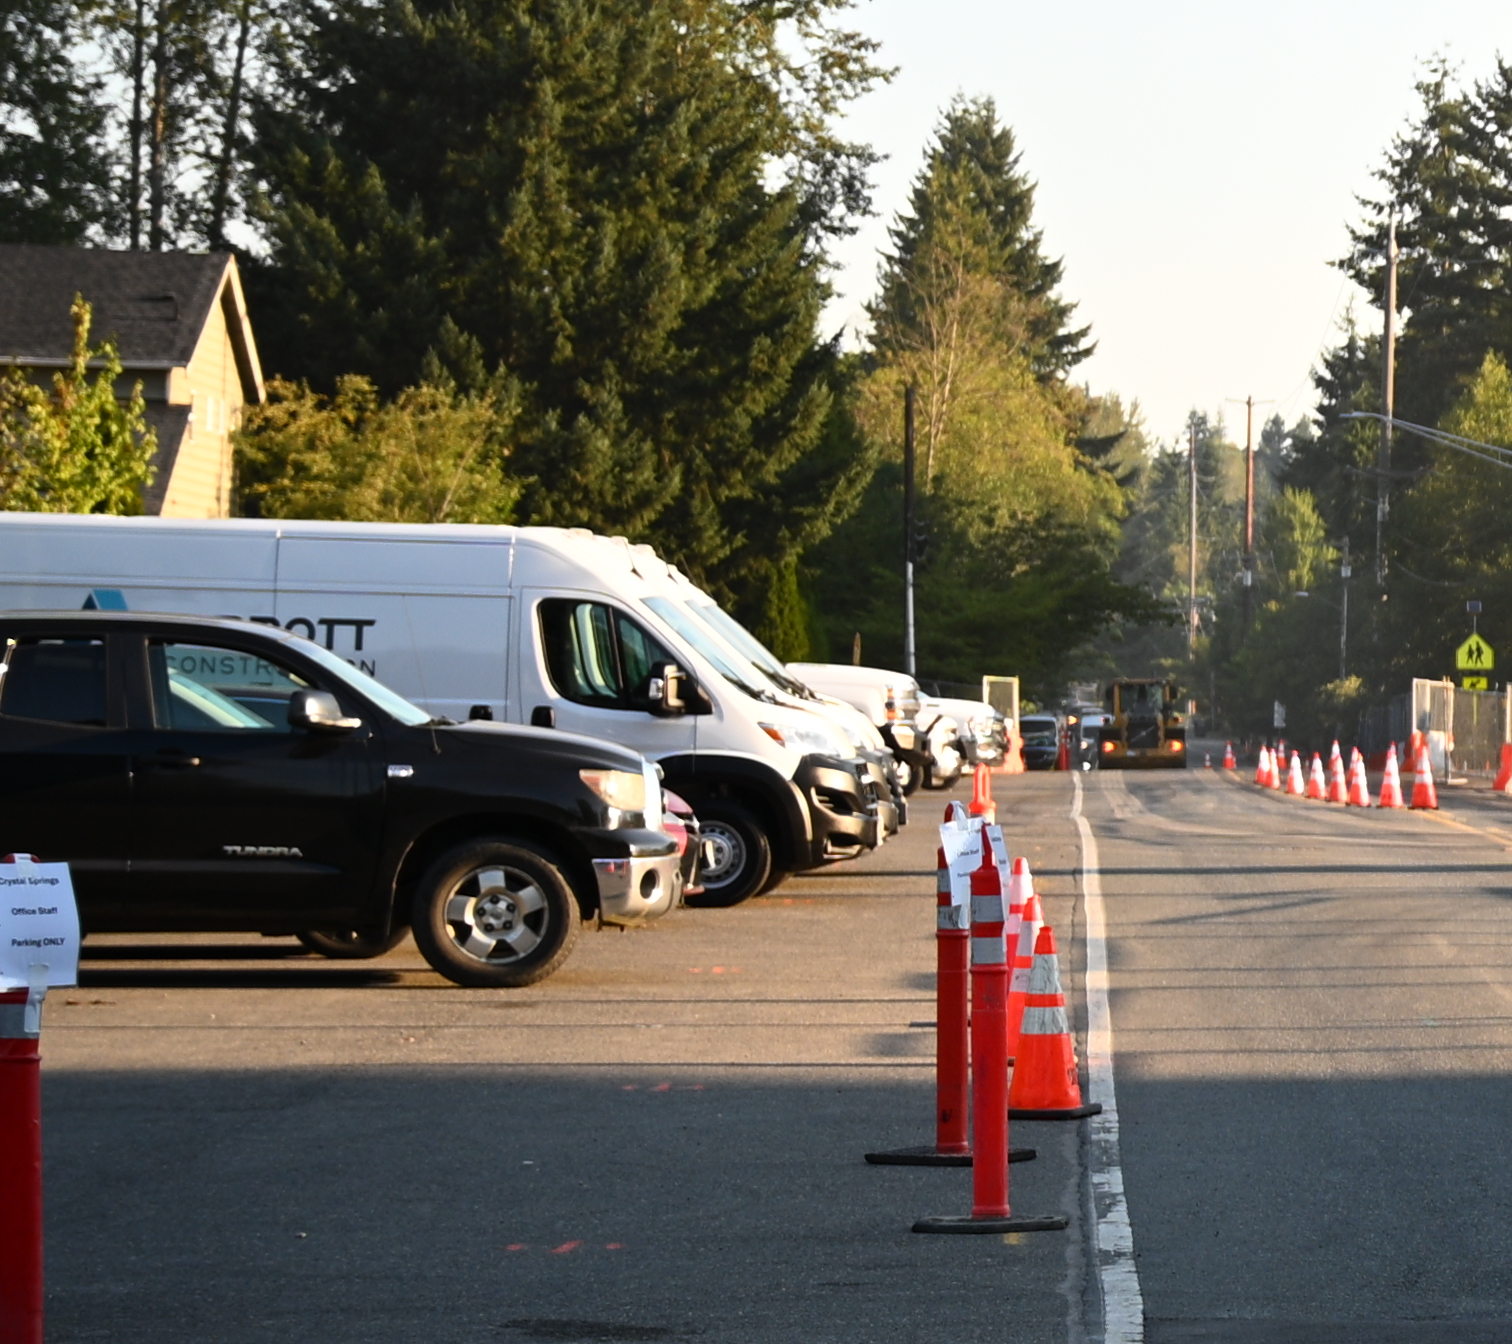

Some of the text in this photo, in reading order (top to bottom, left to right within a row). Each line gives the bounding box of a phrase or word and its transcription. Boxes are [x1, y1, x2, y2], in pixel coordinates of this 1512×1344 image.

[223, 845, 303, 858] TUNDRA
[0, 877, 59, 887] Crystal Springs
[11, 906, 58, 916] Office Staff
[11, 937, 65, 948] Parking ONLY
